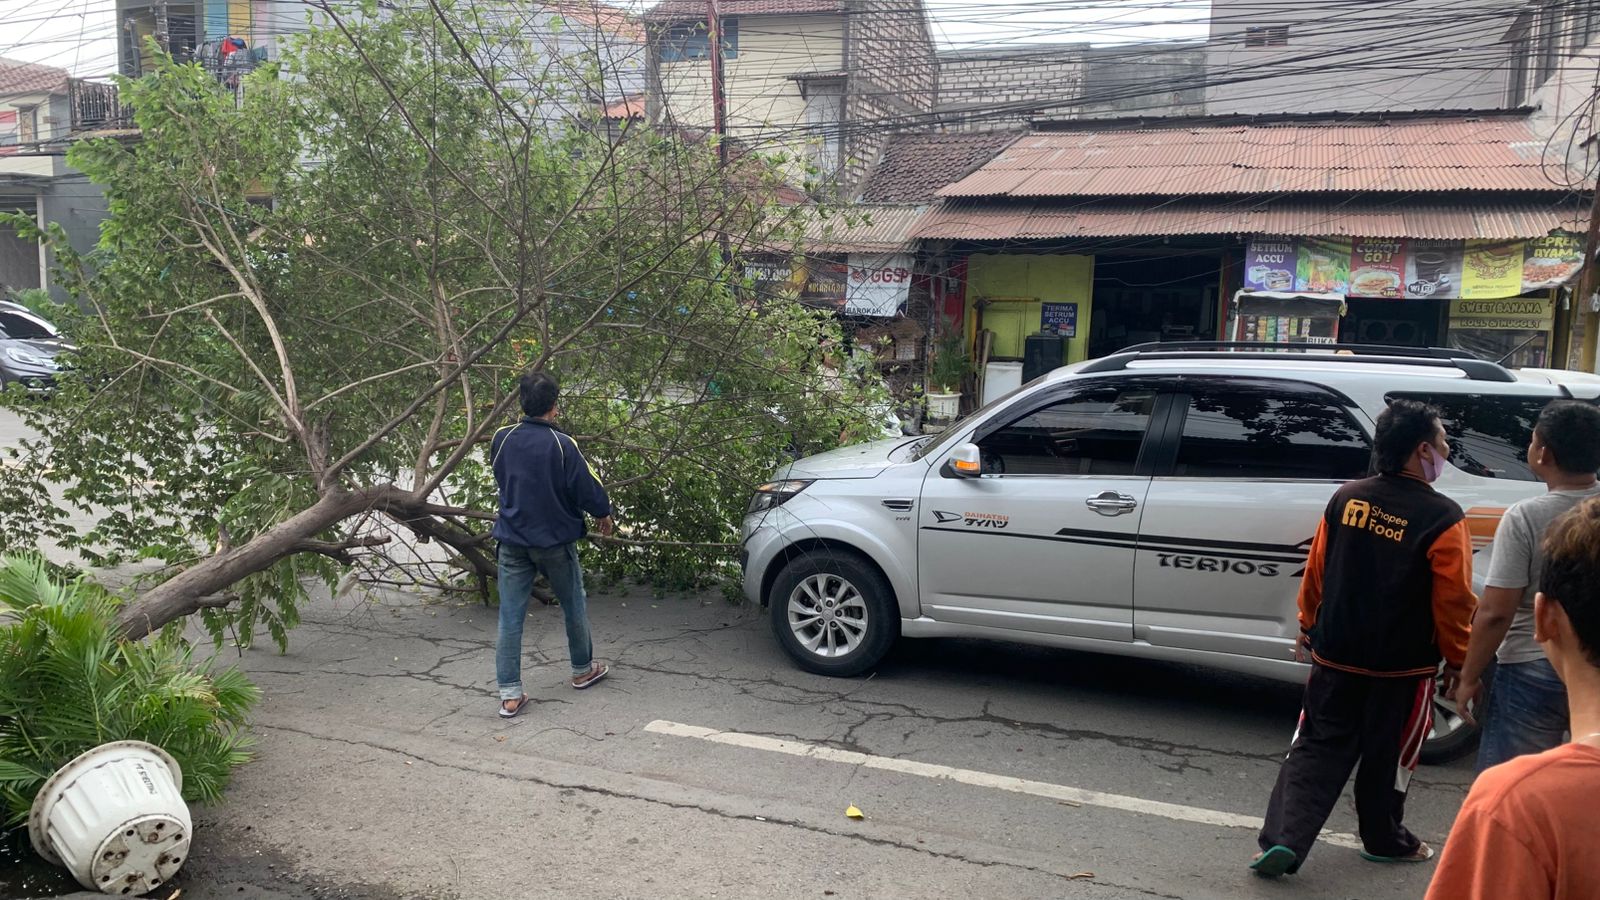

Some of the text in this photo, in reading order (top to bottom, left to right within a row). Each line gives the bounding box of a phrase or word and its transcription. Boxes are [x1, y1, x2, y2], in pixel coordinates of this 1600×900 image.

[1250, 243, 1293, 253] SETRUM
[1533, 248, 1574, 258] AYAM
[1255, 254, 1285, 264] ACCU
[870, 267, 909, 283] GGSP
[847, 307, 882, 315] BAROKAH
[1460, 302, 1542, 314] SWEET BANANA
[1461, 319, 1487, 328] ROLL
[1499, 320, 1541, 329] NUGGET
[964, 511, 1009, 521] DAIHATSU
[1371, 505, 1408, 527] Shopee
[964, 518, 1009, 528] ダイハツ
[1368, 519, 1404, 542] Food
[1156, 553, 1280, 577] TERIOS
